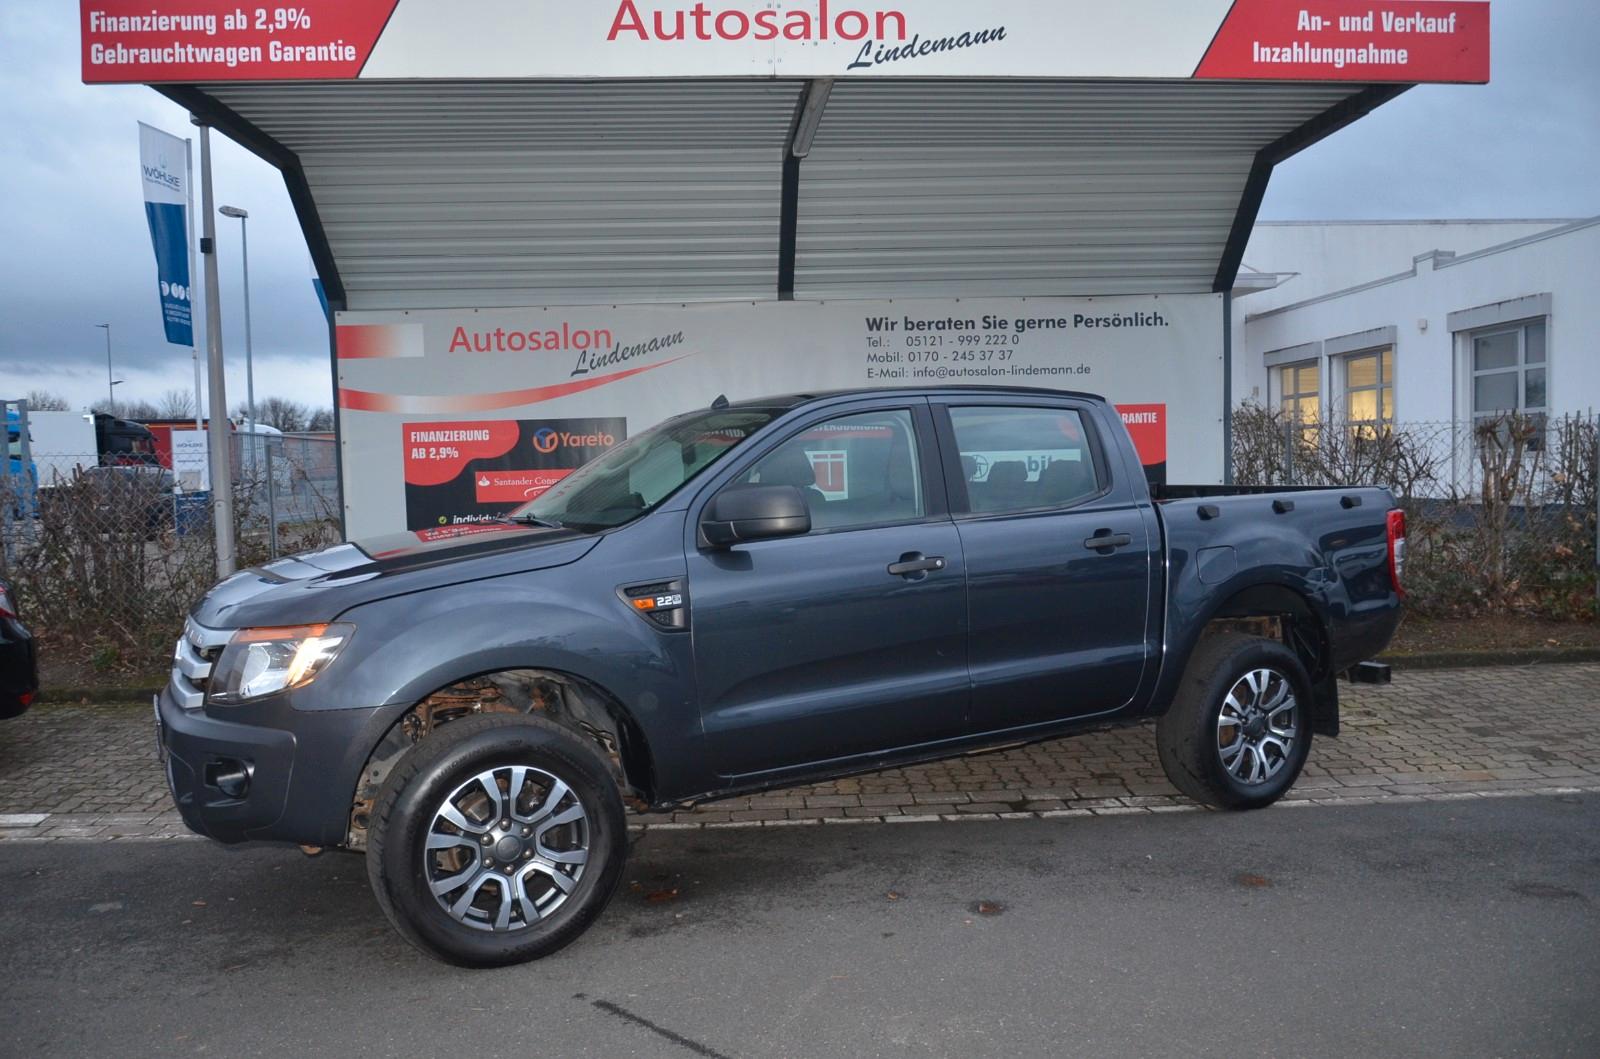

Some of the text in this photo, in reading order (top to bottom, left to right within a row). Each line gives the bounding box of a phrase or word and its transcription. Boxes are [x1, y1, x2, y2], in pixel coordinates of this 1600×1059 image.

[90, 8, 312, 35] Finanzierung ab 2,9%
[606, 0, 907, 41] Autosalon
[1297, 10, 1457, 34] An- und Verkauf
[90, 39, 357, 68] Gebrauchtwagen Garantie
[847, 25, 1008, 71] Lindemann
[1253, 41, 1409, 68] Inzahlungnahme
[865, 312, 1169, 334] Wir beraten Sie gerne Persönlich.
[449, 322, 613, 353] Autosalon
[866, 336, 890, 348] Tel.:
[906, 335, 944, 347] 05121
[957, 334, 981, 347] 999
[985, 334, 1008, 346] 222
[1011, 334, 1020, 346] 0
[570, 330, 685, 377] Lindemann
[866, 351, 904, 363] Mobil:
[908, 351, 939, 363] 0170
[952, 350, 975, 362] 245
[979, 350, 994, 362] 37
[998, 349, 1013, 361] 37
[867, 363, 1091, 379] E-Mail: info@autosalon-lindemann.de
[411, 429, 490, 443] FINANZIERUNG
[560, 431, 614, 448] Yareto
[411, 446, 459, 461] AB 2,9%
[494, 476, 533, 486] Santander
